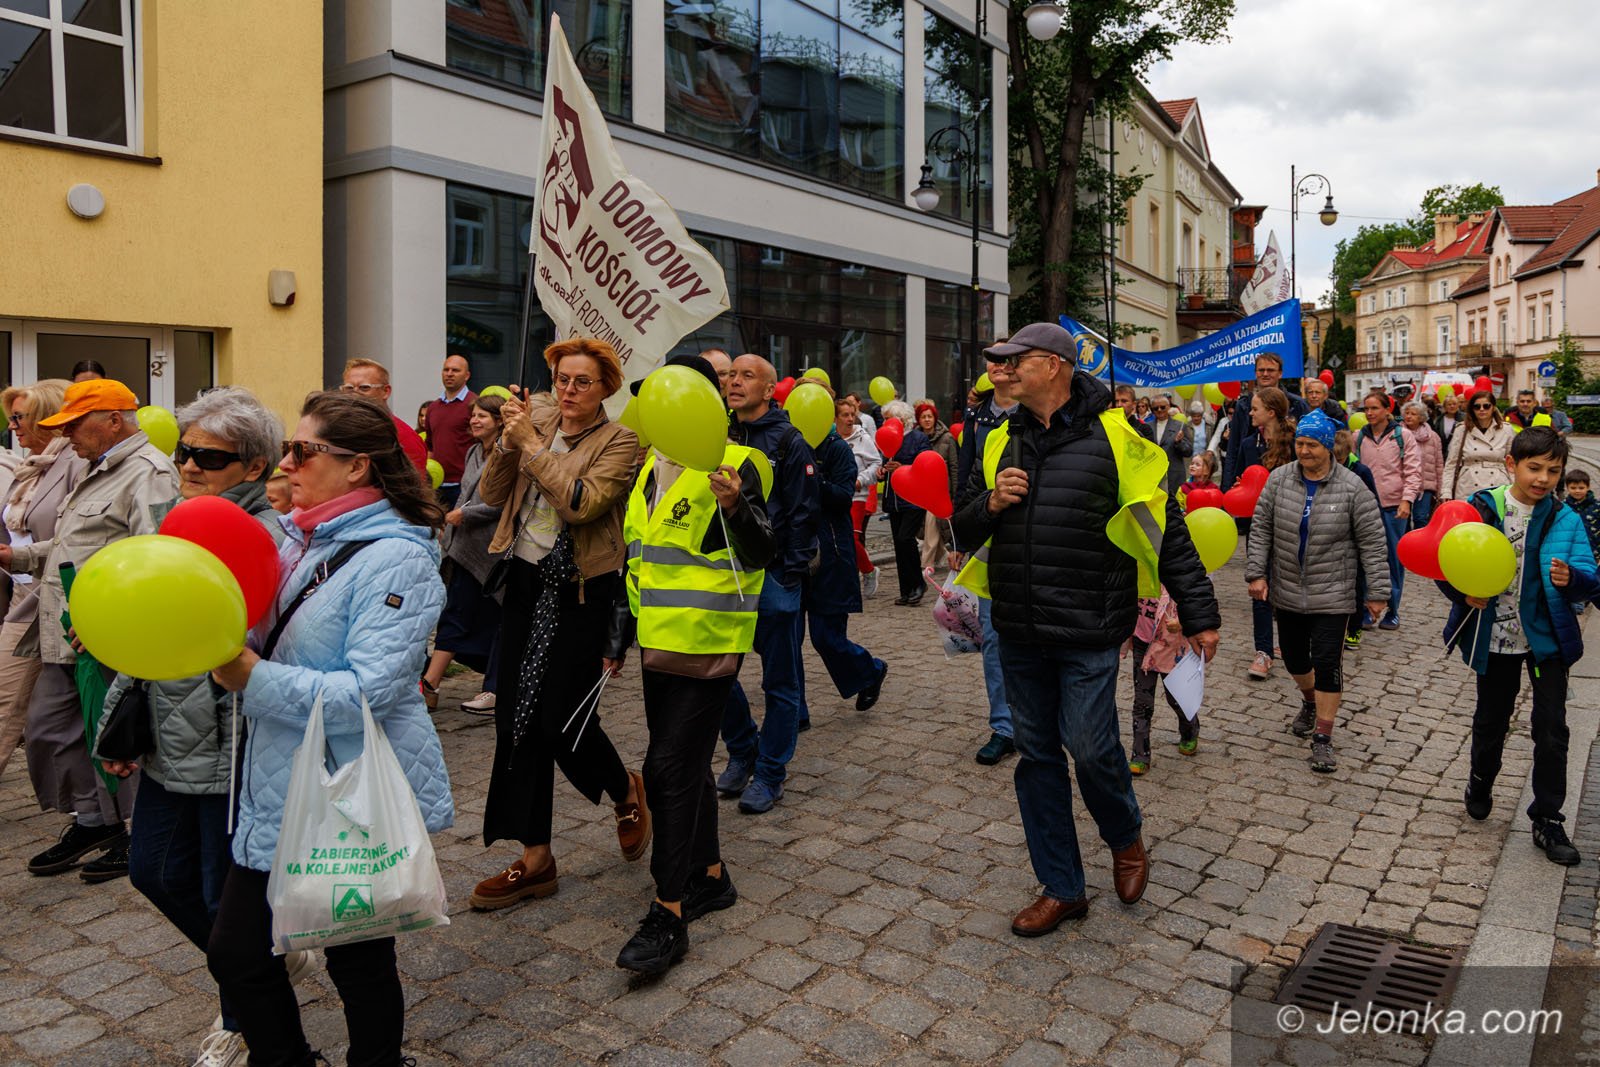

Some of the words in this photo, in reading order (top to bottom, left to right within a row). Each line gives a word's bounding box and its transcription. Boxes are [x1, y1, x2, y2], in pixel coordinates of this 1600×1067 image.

[599, 180, 711, 304] DOMOWY
[576, 224, 661, 336] KOŚCIÓŁ
[576, 299, 634, 366] RODZINNA
[1209, 335, 1232, 350] AKCJI
[1233, 314, 1285, 341] KATOLICKIEJ
[151, 361, 163, 377] 2
[1124, 360, 1148, 373] PRZY
[1204, 350, 1227, 367] BOŻEJ
[1227, 332, 1285, 358] MIŁOSIERDZIA
[1135, 378, 1145, 386] W
[306, 863, 367, 875] KOLEJNE
[310, 847, 368, 860] ZABIERZ
